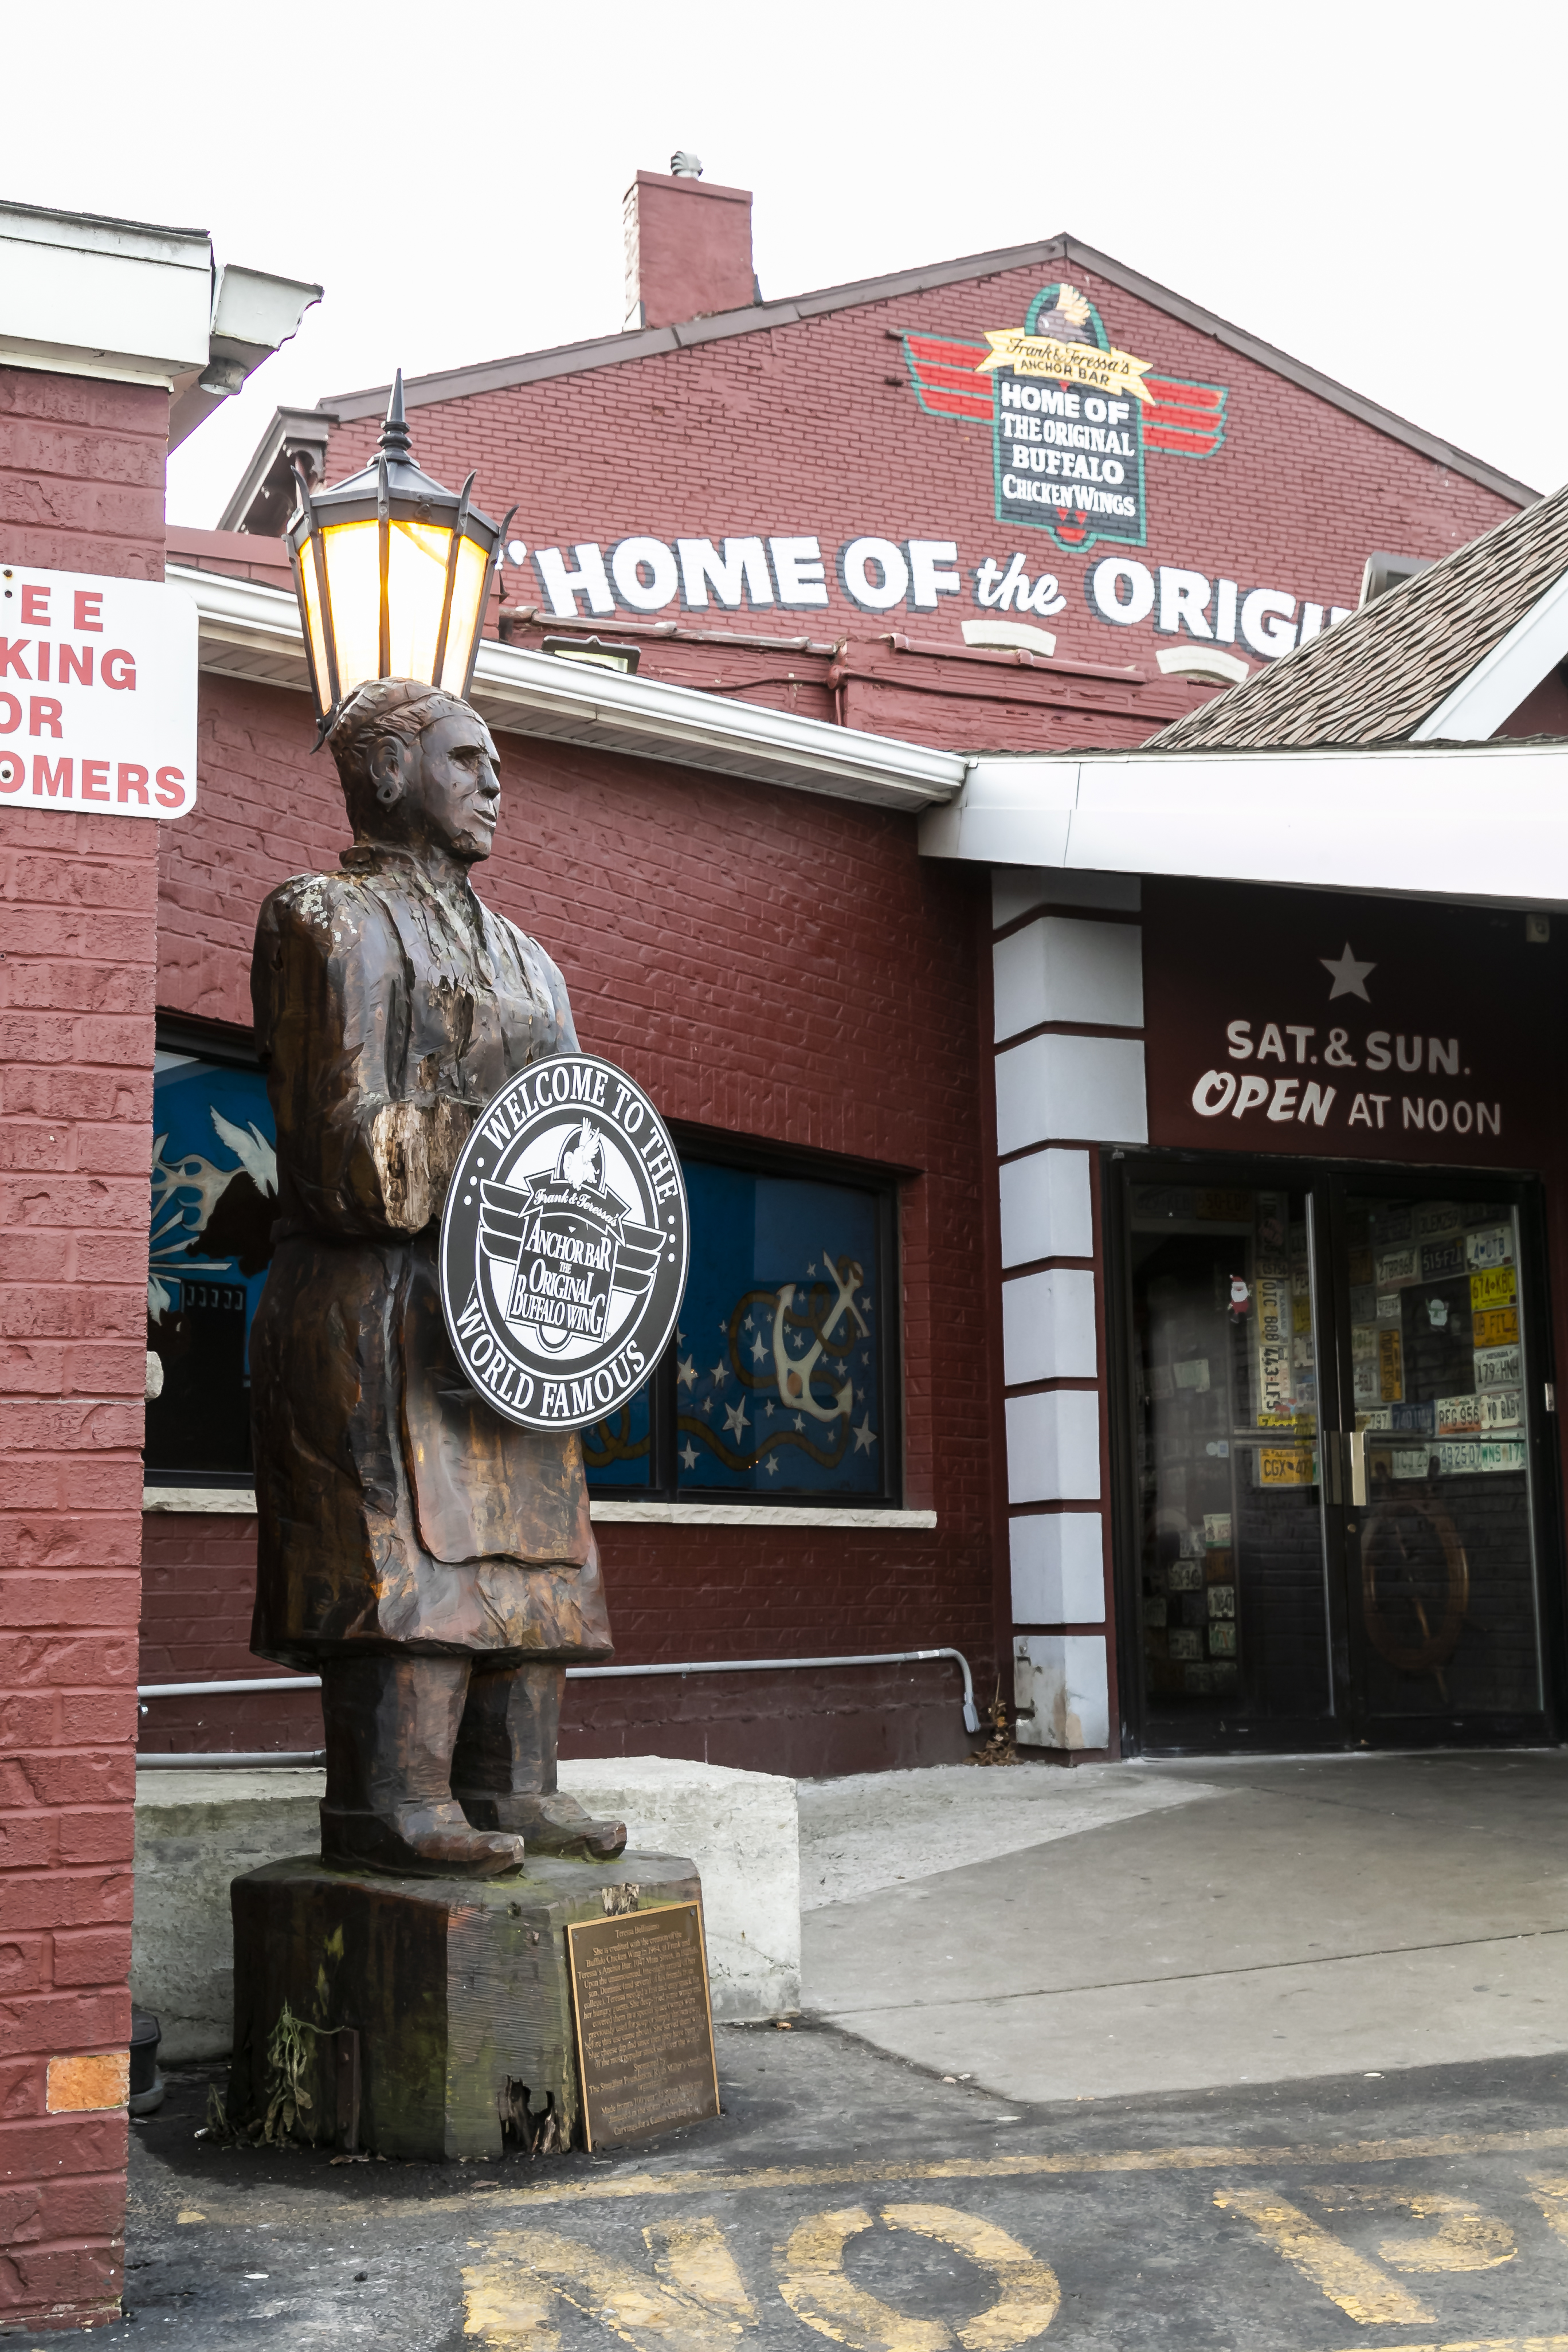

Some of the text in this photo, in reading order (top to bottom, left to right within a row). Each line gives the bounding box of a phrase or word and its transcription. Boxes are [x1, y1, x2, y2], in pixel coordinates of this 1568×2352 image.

[1020, 359, 1110, 386] ANCHOR BAR
[1001, 381, 1130, 425] HOME OF
[1000, 412, 1135, 457] THE ORIGINAL
[1011, 444, 1124, 485] BUFFALO
[844, 536, 961, 609] OF
[976, 552, 1068, 617] the
[1093, 556, 1357, 660] ORIGI
[0, 637, 136, 691] KING
[0, 691, 64, 739] OR
[0, 750, 186, 809] OMERS
[1366, 1031, 1471, 1075] SUN.
[1191, 1069, 1500, 1135] OPEN AT NOON
[481, 1065, 679, 1205] WELCOME TO THE
[533, 1188, 569, 1205] Frank
[577, 1193, 620, 1227] Teressa's
[524, 1217, 611, 1272] ANCHOR BAR
[559, 1261, 572, 1275] THE
[511, 1274, 606, 1335] BUFFALO WING
[529, 1259, 595, 1306] ORIGINAL
[457, 1297, 646, 1418] WORLD FAMOUS
